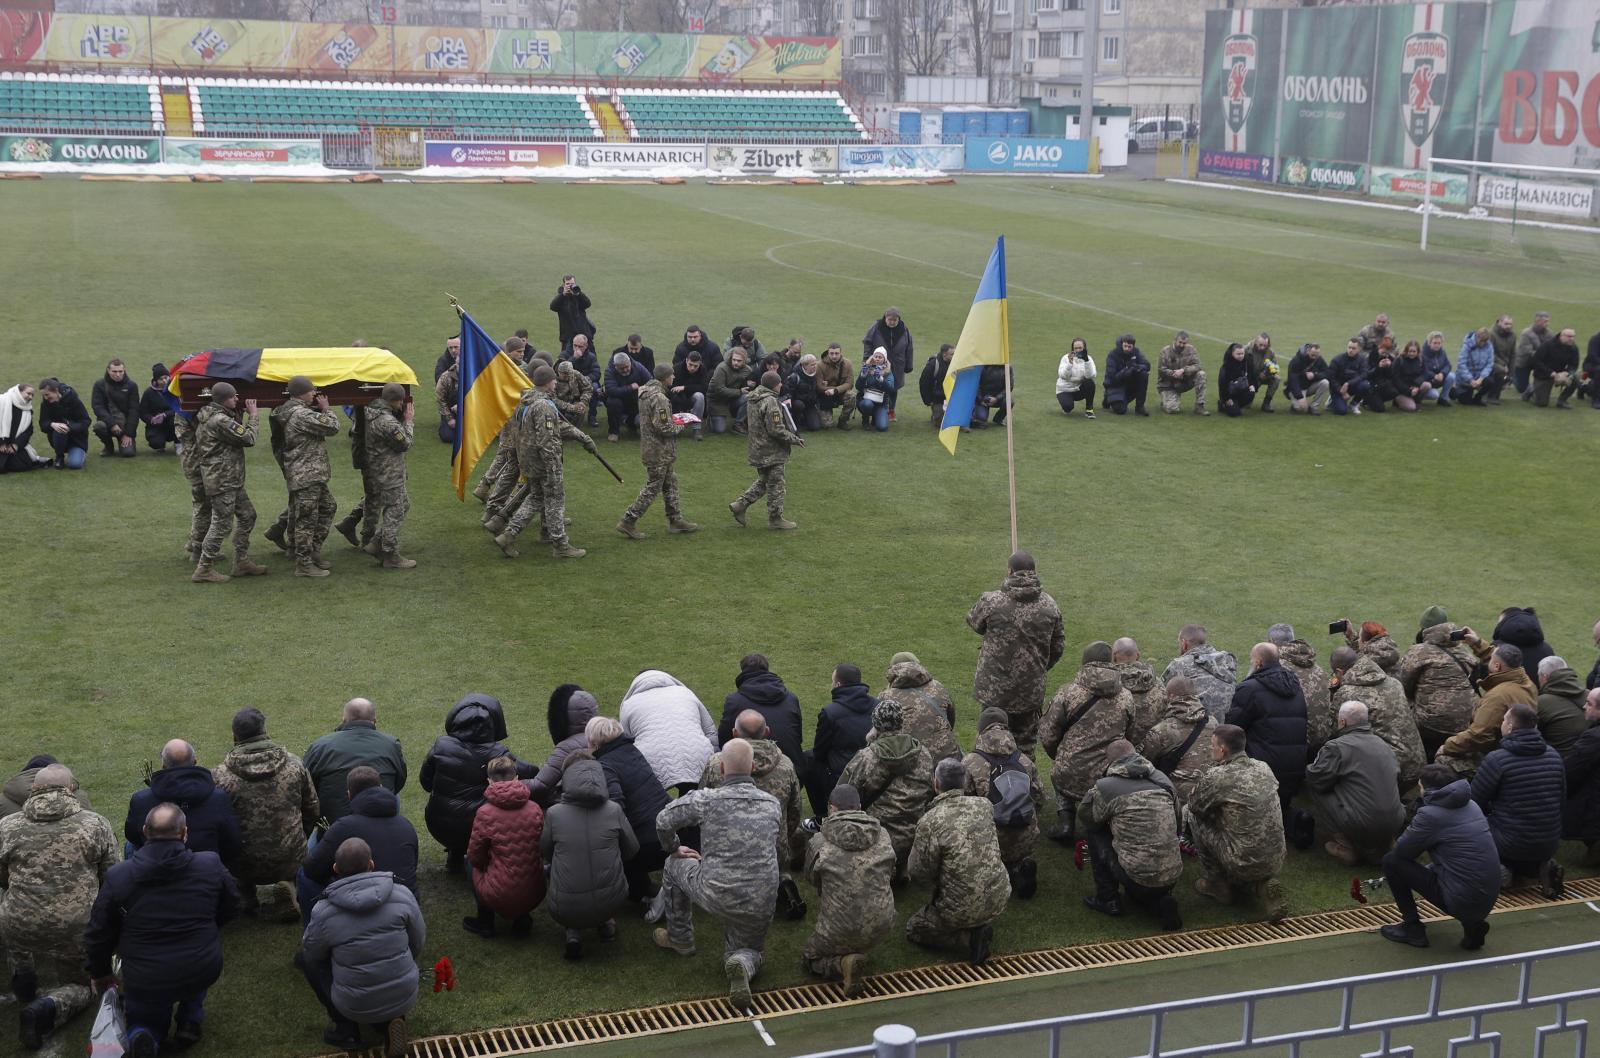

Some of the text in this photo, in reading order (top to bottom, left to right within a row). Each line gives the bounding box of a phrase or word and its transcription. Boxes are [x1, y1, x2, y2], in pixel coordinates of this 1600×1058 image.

[381, 7, 397, 22] 13
[690, 17, 704, 31] 14
[84, 24, 129, 42] APP
[513, 38, 549, 54] LEE
[1284, 76, 1367, 104] ОБОЛОНЬ
[61, 143, 148, 159] ОБОЛОНЬ
[744, 149, 803, 167] Zibert
[1013, 144, 1063, 161] JAKO
[1214, 154, 1259, 171] FAVBET
[1311, 167, 1356, 186] ОБОЛОНЬ
